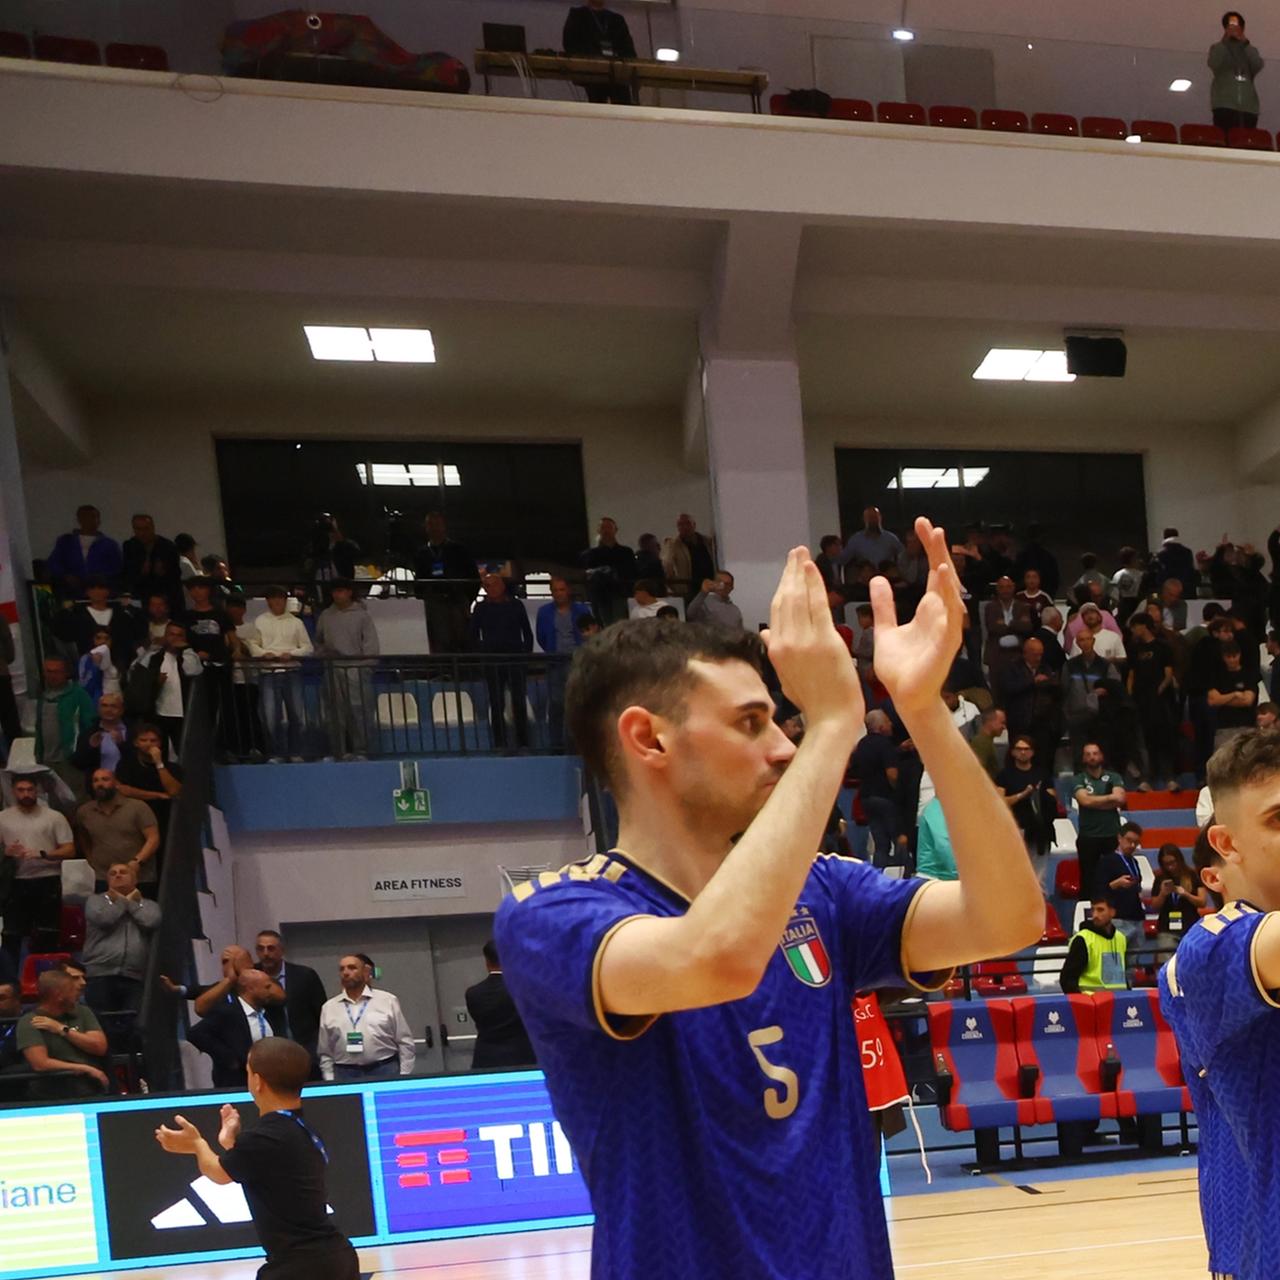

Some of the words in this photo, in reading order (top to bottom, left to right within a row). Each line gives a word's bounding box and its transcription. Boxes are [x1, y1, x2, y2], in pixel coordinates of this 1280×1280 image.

[374, 880, 408, 891] AREA
[411, 877, 462, 889] FITNESS
[748, 1025, 799, 1120] 5
